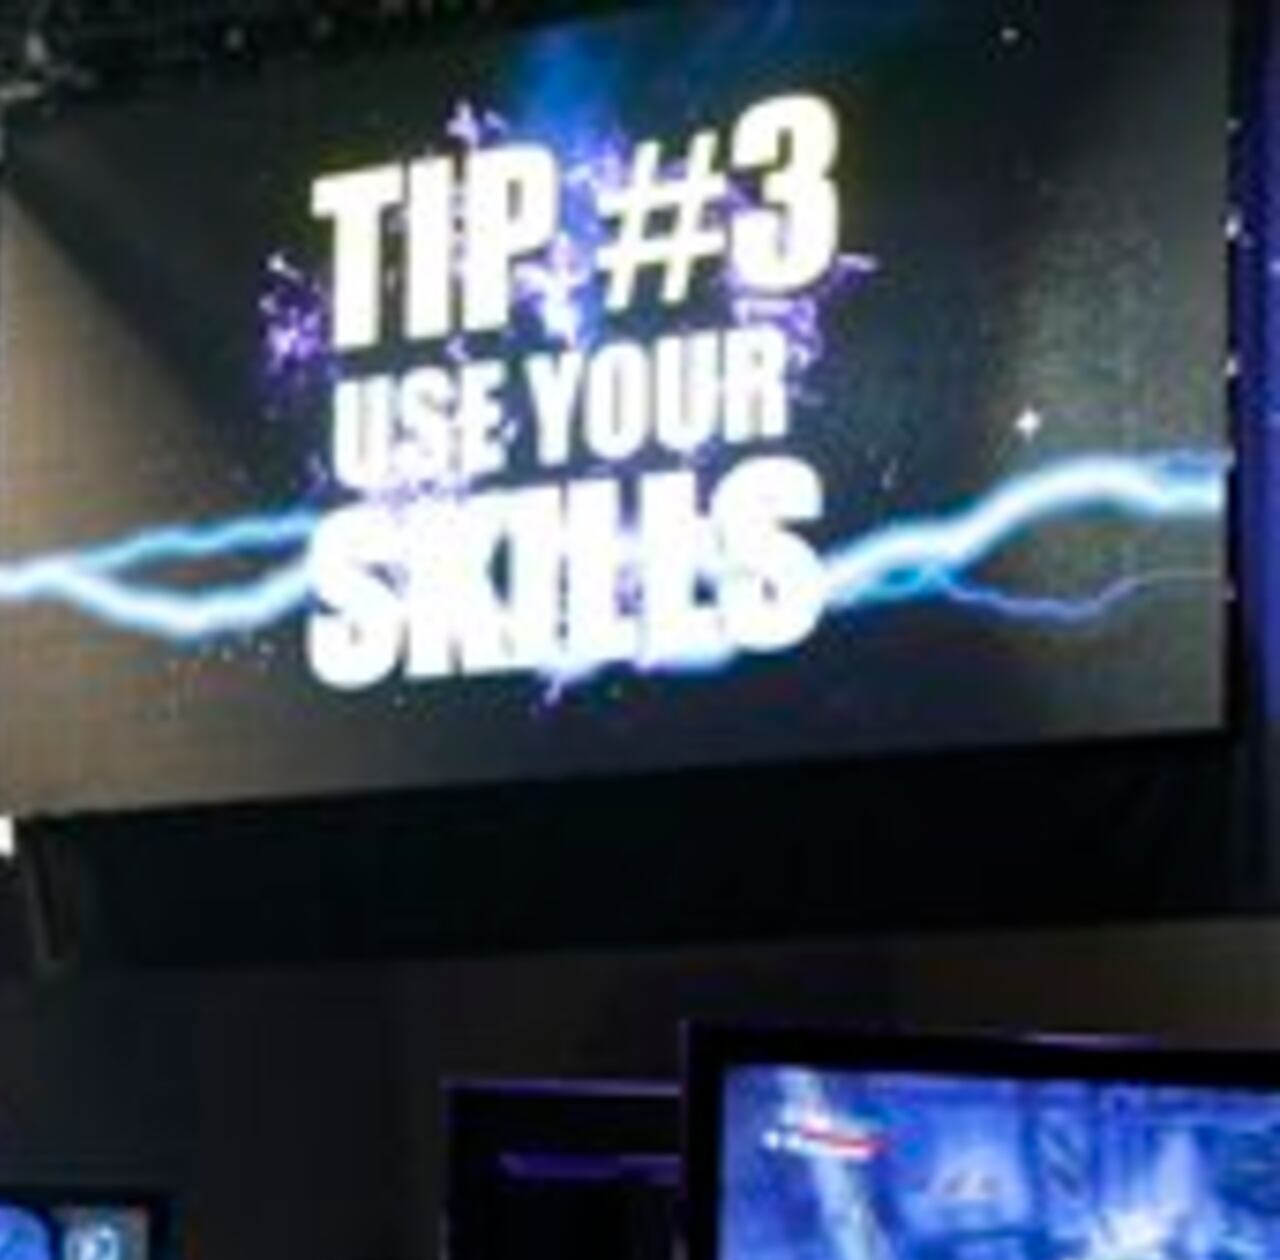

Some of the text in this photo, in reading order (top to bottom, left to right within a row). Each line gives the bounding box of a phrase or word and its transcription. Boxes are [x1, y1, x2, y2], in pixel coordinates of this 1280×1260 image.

[312, 93, 840, 351] TIP #3
[332, 327, 789, 491] USE YOUR
[306, 456, 827, 690] SKILLS
